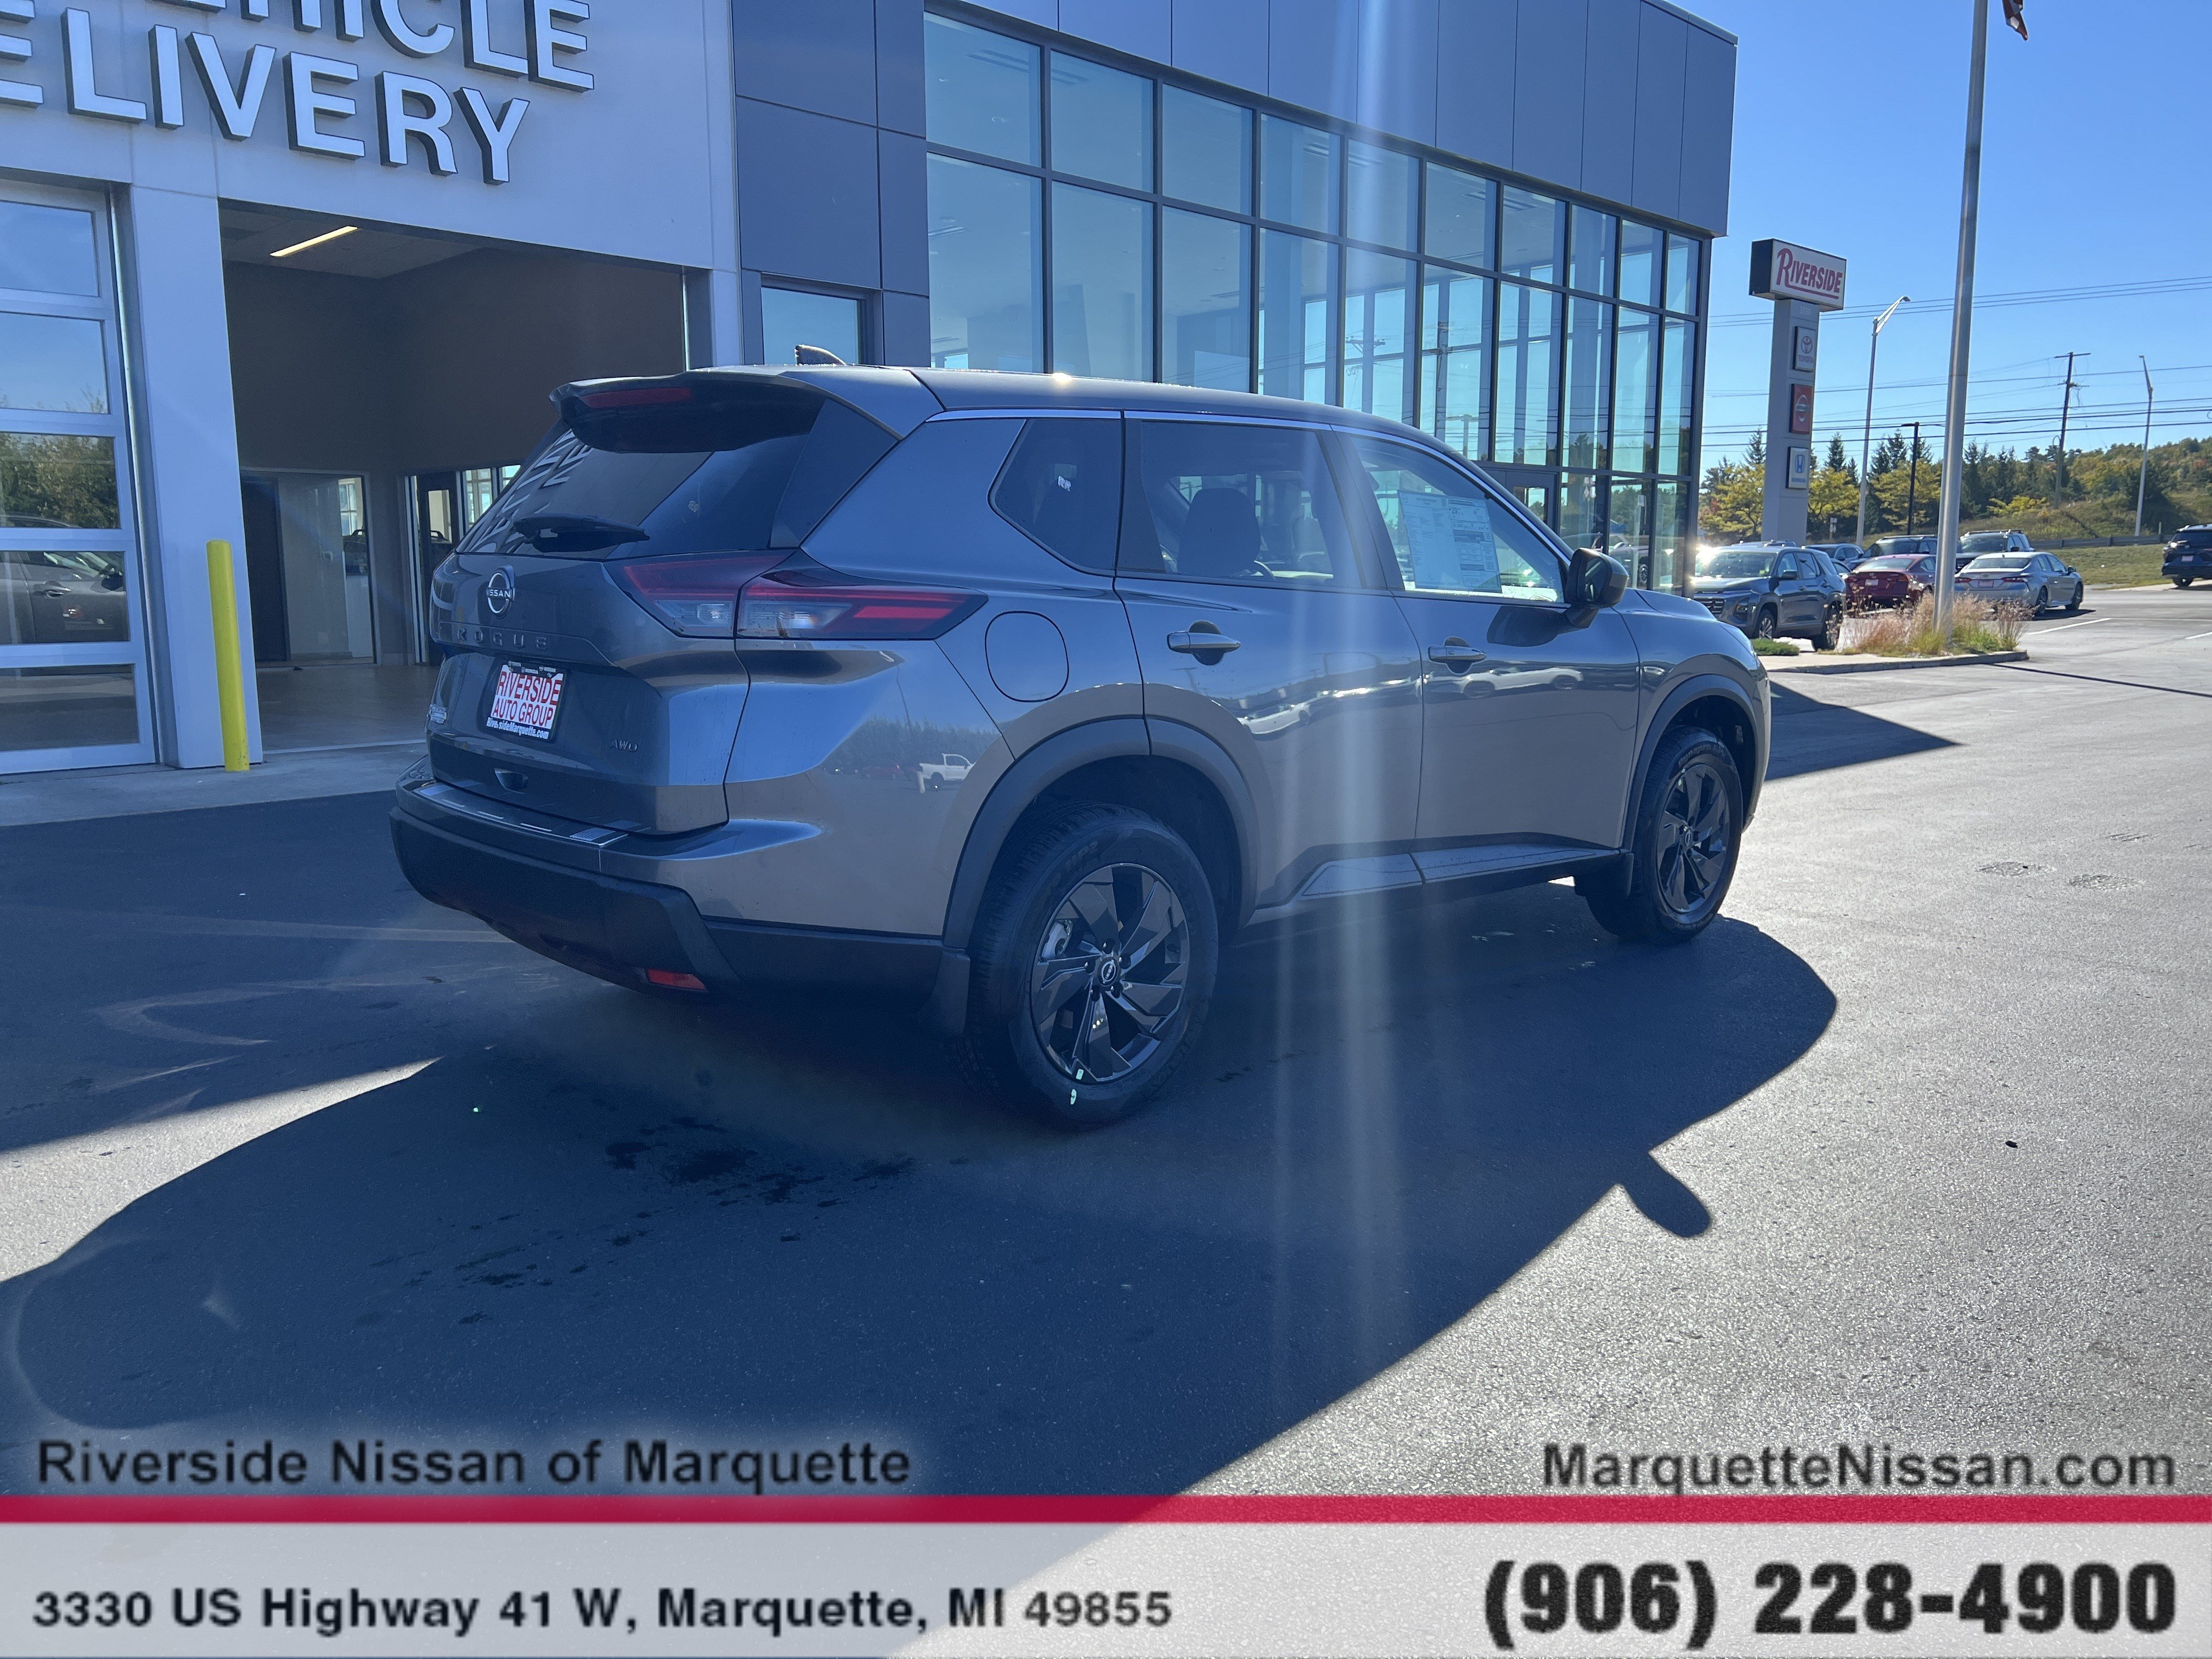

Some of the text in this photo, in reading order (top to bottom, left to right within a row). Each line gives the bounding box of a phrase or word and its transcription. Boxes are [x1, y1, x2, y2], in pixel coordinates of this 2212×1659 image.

[457, 628, 548, 651] ROGUE
[496, 671, 563, 706] RIVERSIDE
[492, 698, 554, 727] AUTO GROUP
[610, 739, 638, 752] AWD
